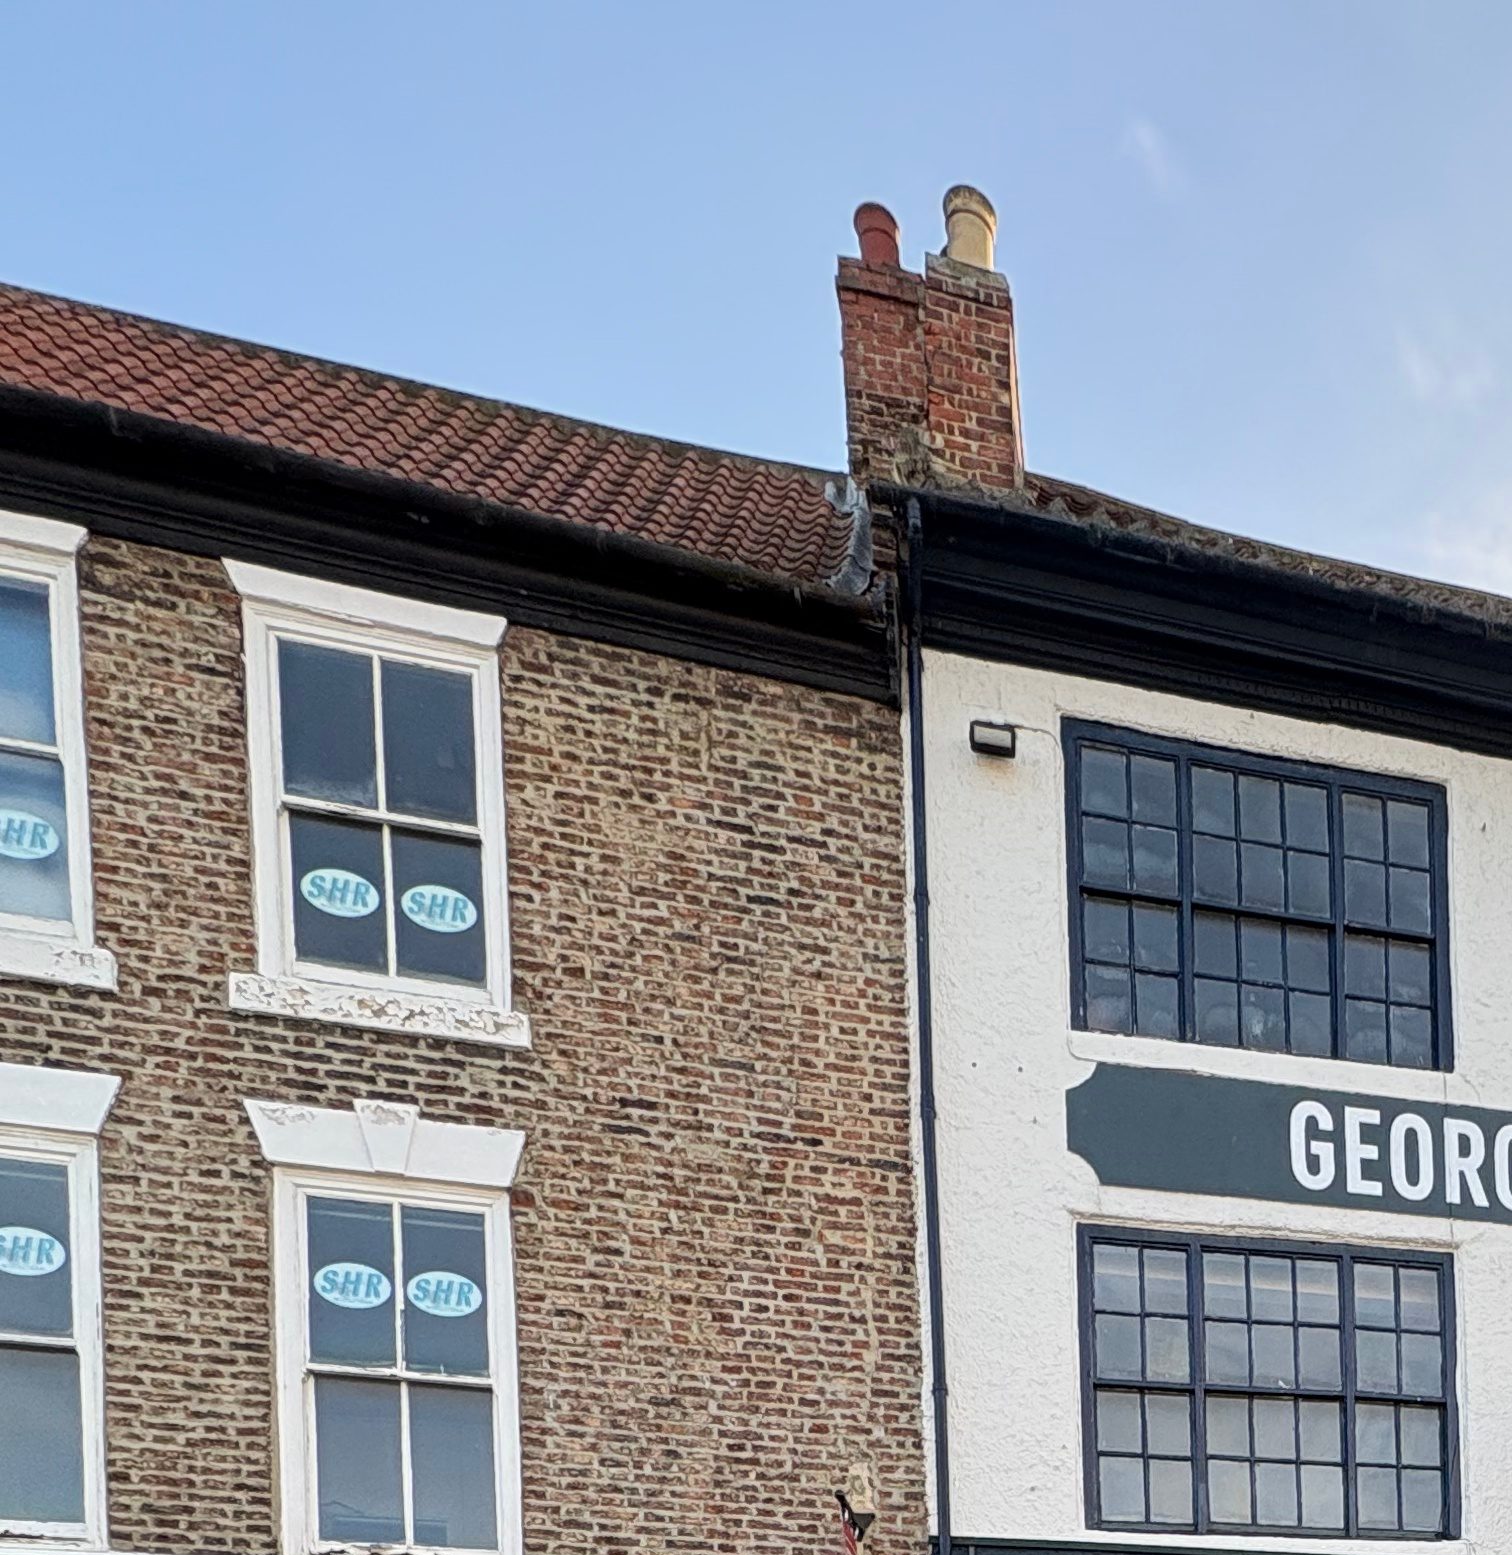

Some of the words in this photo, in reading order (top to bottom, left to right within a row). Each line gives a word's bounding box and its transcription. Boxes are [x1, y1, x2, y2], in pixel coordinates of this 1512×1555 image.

[0, 816, 50, 850] HR
[307, 874, 371, 908] SHR
[407, 891, 470, 924] SHR
[320, 1269, 384, 1300] SHR
[413, 1278, 474, 1308] SHR
